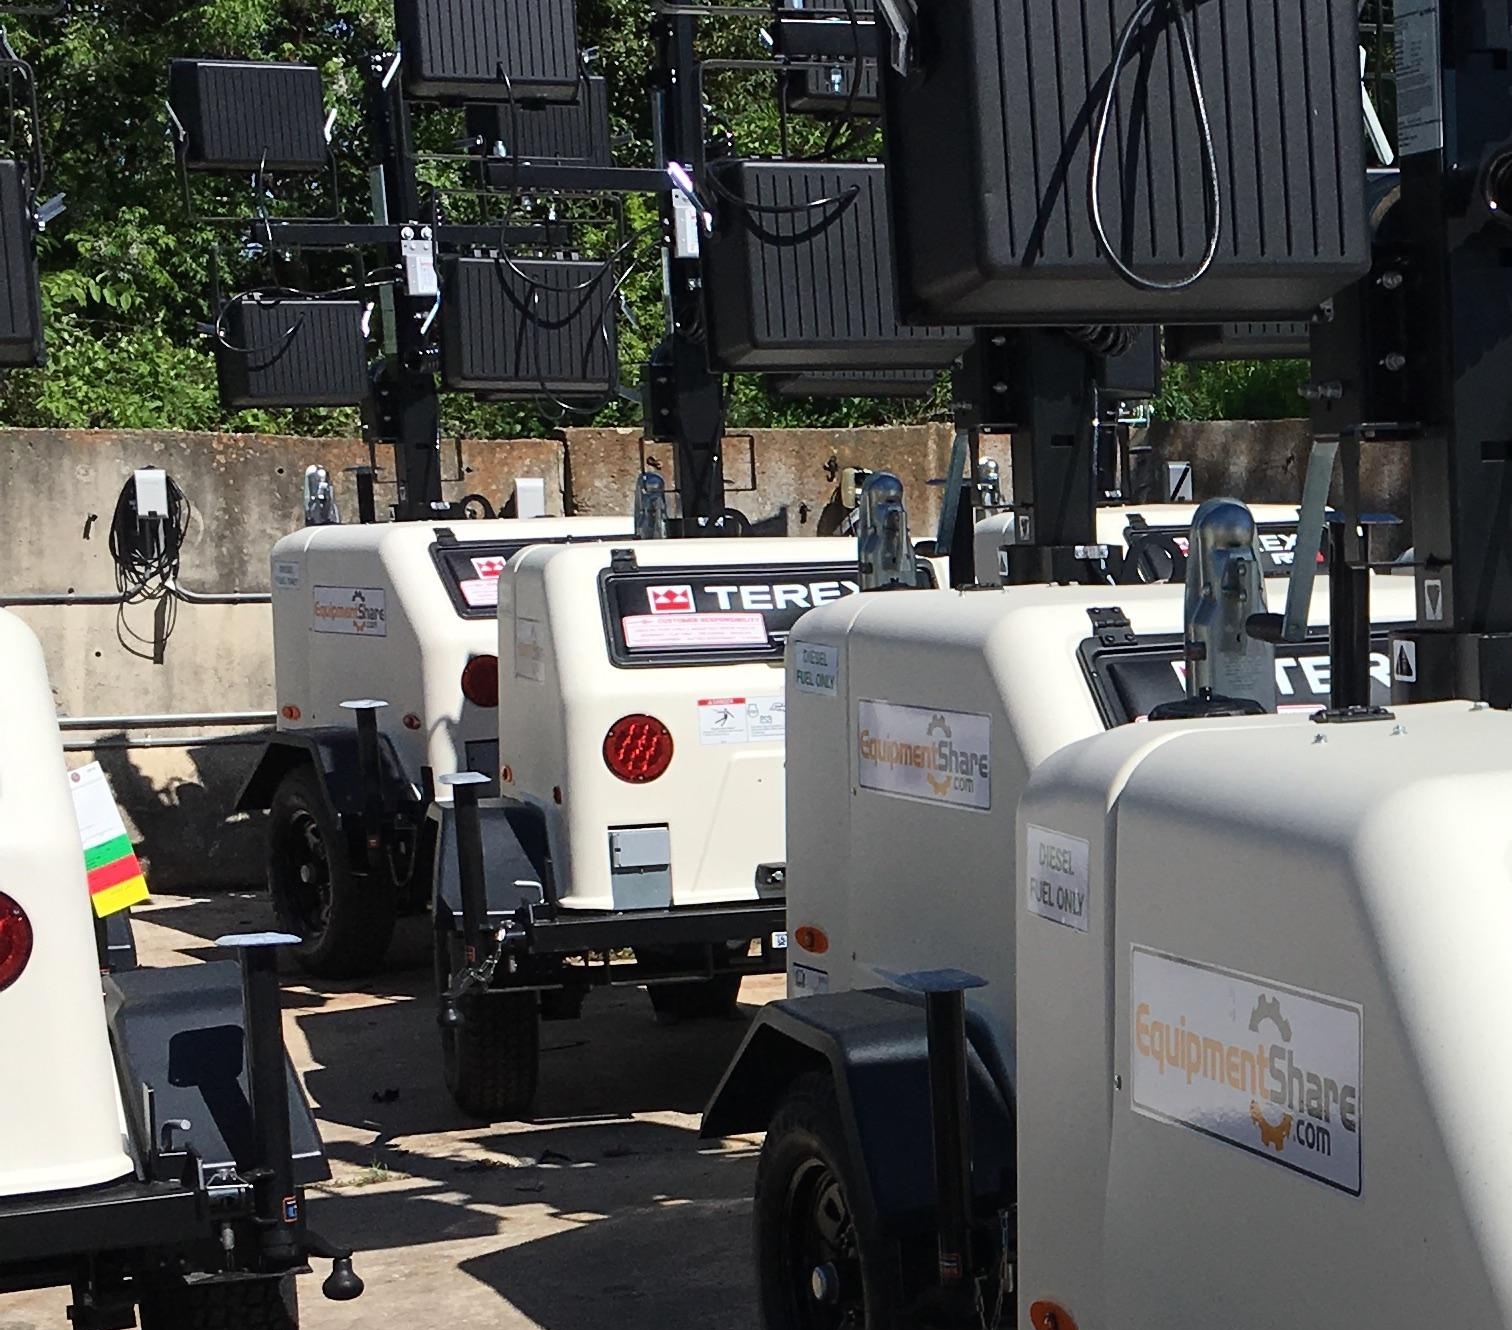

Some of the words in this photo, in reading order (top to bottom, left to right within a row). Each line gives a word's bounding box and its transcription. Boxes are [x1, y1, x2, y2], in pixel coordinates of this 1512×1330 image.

[802, 648, 828, 666] DIESEL
[796, 670, 815, 687] FUEL
[816, 673, 835, 690] ONLY
[860, 729, 989, 778] EquipmentShare
[1038, 842, 1075, 877] DIESEL
[1030, 878, 1055, 907] FUEL
[1056, 886, 1086, 918] ONLY
[1135, 1001, 1358, 1134] EquipmentShare
[1292, 1118, 1331, 1157] .com
